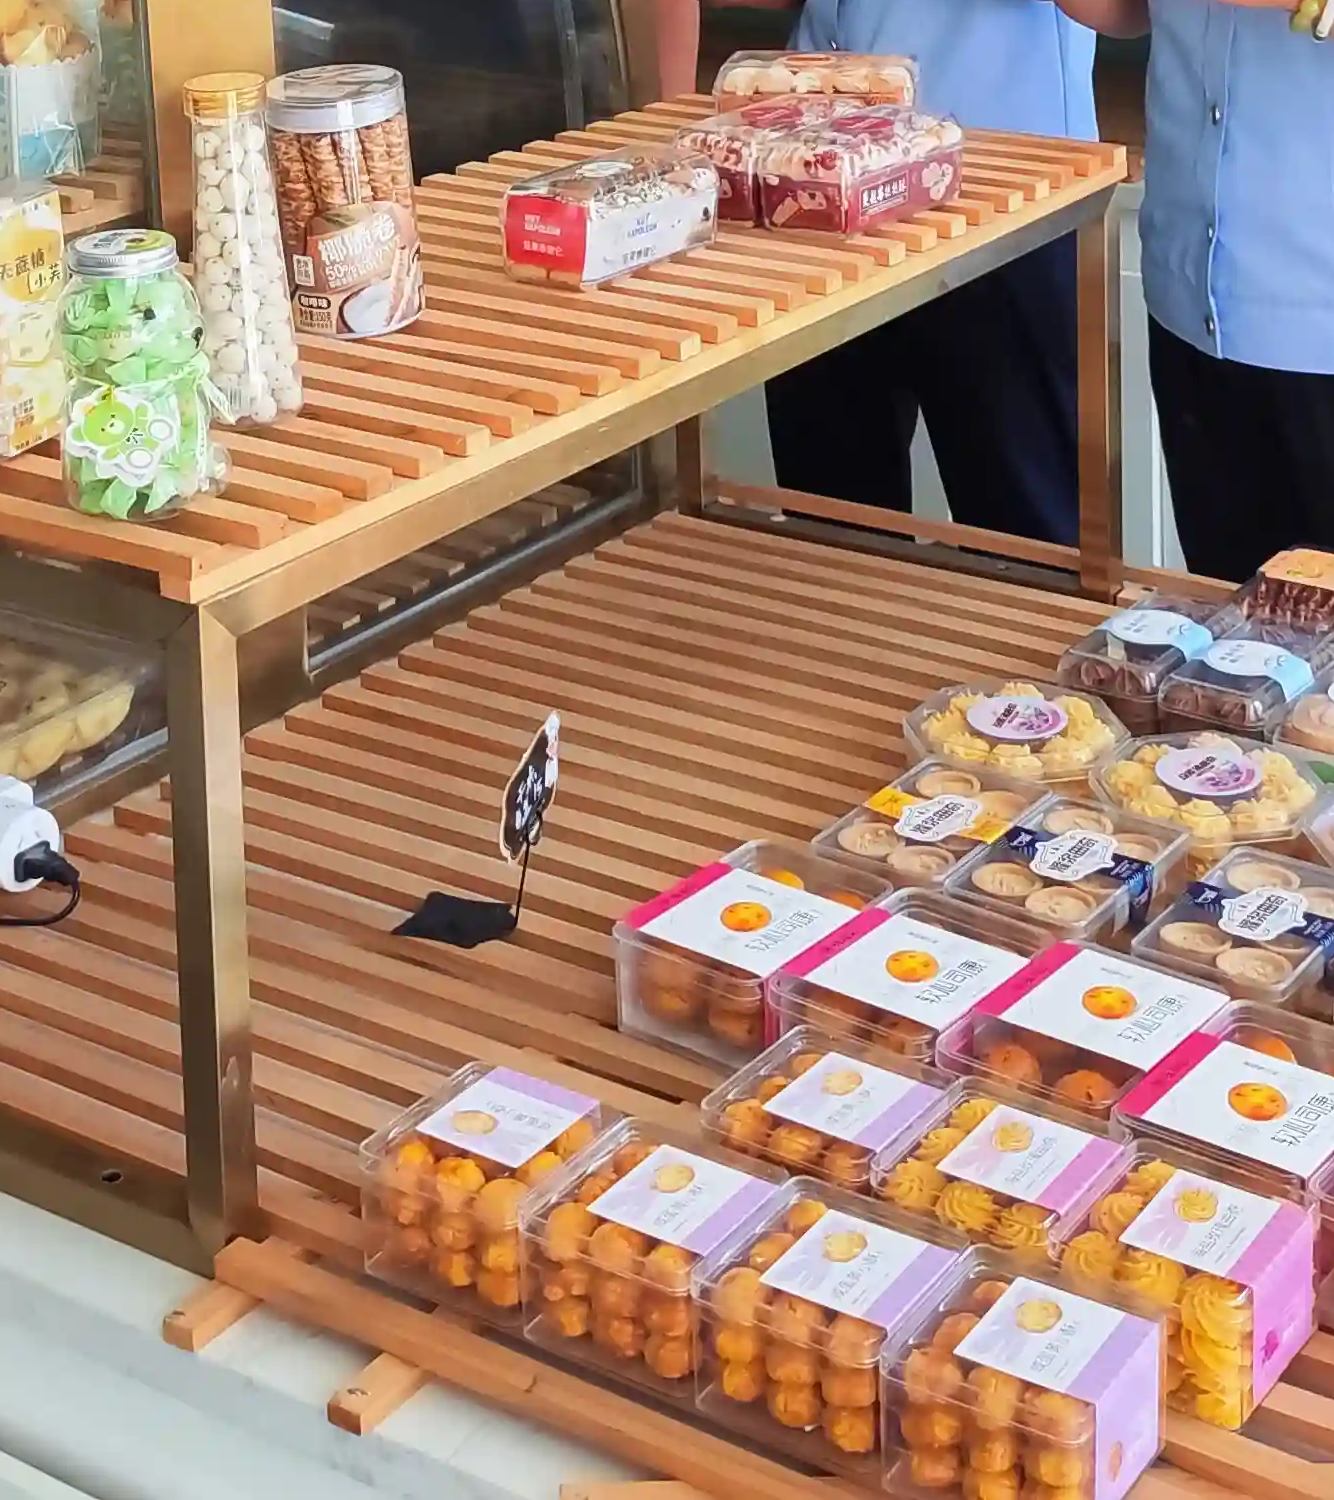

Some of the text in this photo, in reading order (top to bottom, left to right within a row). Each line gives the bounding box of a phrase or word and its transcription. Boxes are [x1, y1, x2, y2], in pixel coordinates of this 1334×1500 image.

[744, 908, 815, 952] 软心司康
[915, 959, 985, 1004] 软心司康
[1117, 995, 1185, 1043] 软心司康
